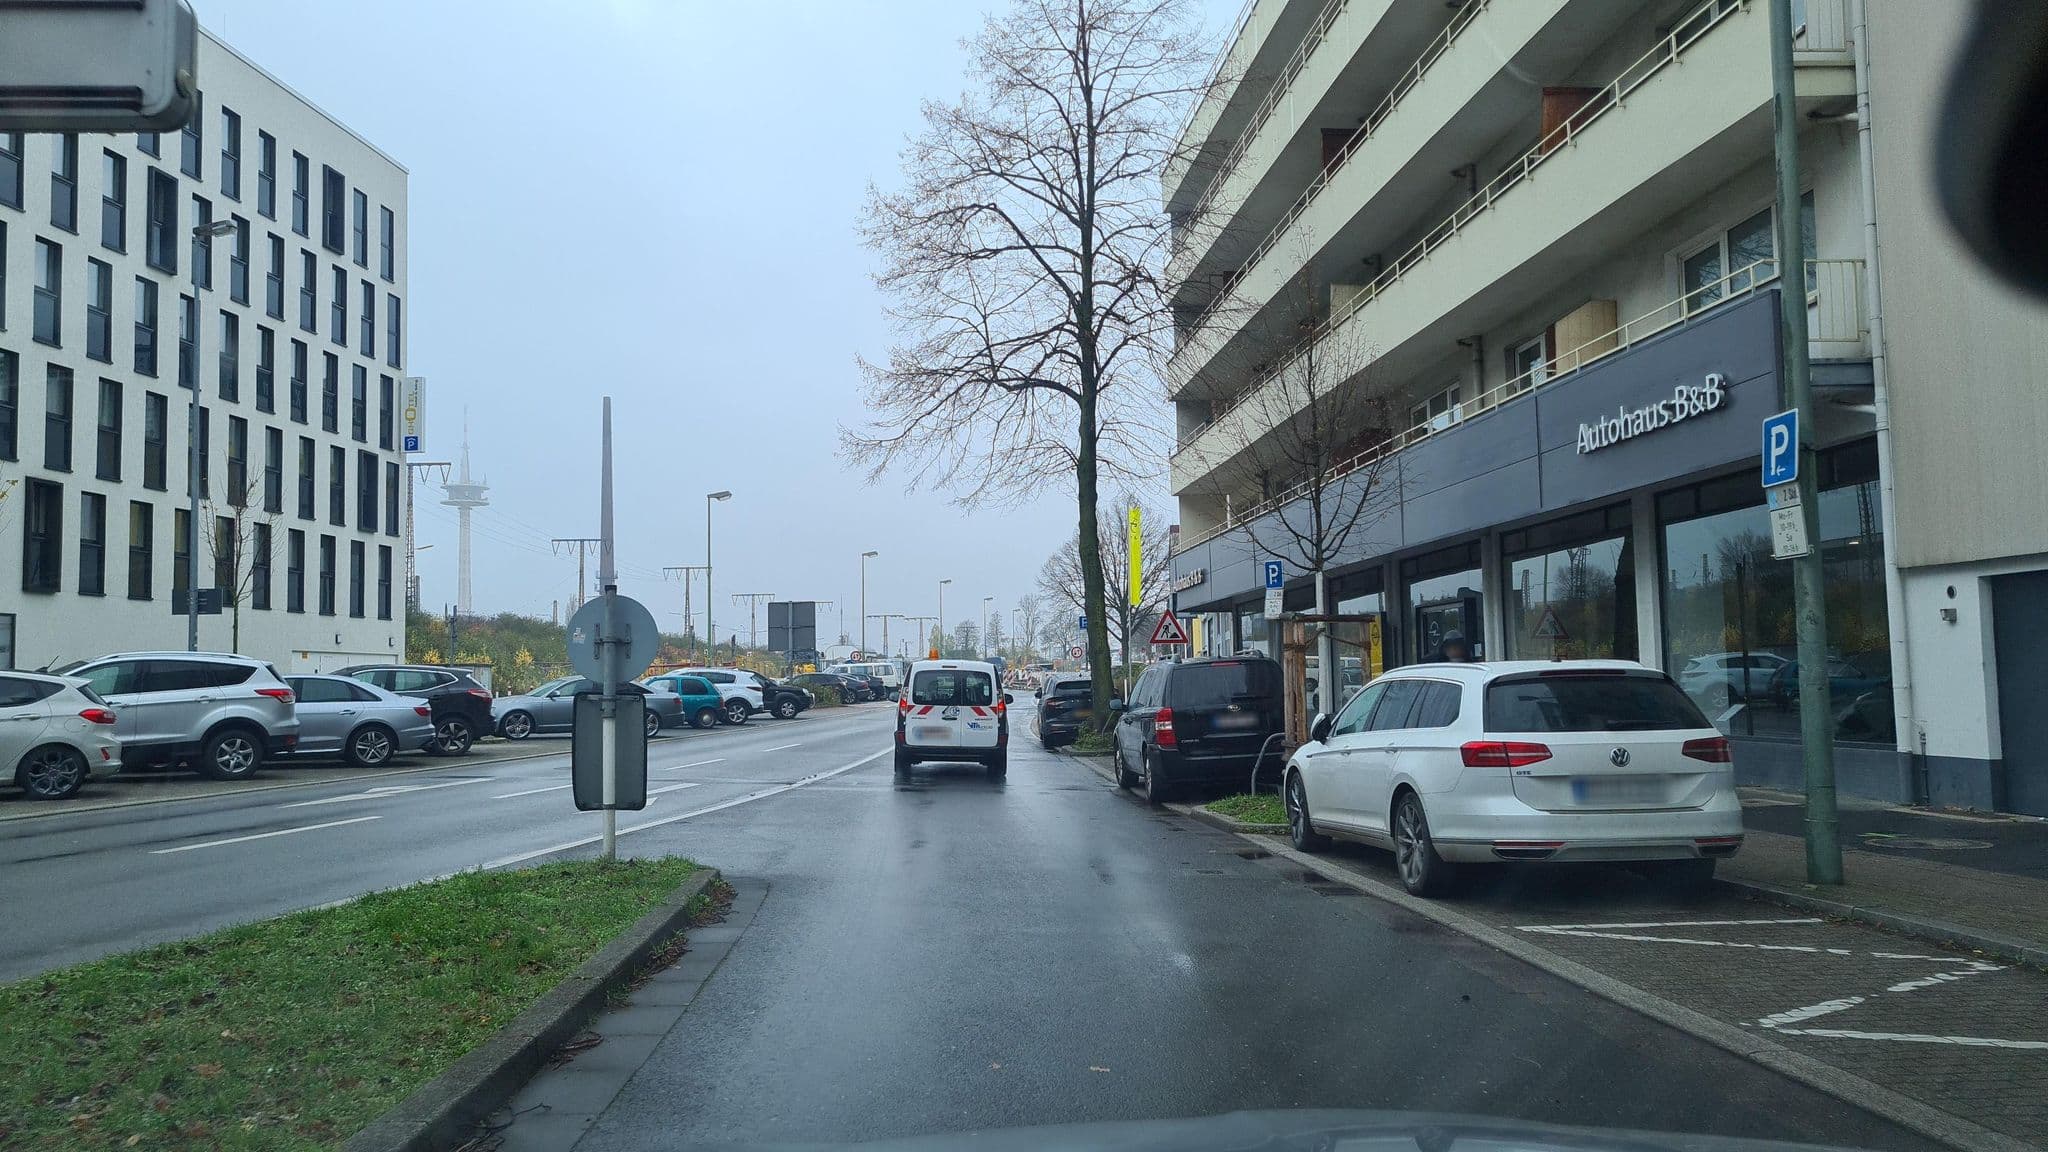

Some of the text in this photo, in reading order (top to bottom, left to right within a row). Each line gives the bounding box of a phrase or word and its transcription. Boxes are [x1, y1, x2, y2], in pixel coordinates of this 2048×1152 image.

[1576, 373, 1726, 454] Autohaus B&B
[1770, 424, 1790, 476] P
[1269, 565, 1279, 585] P
